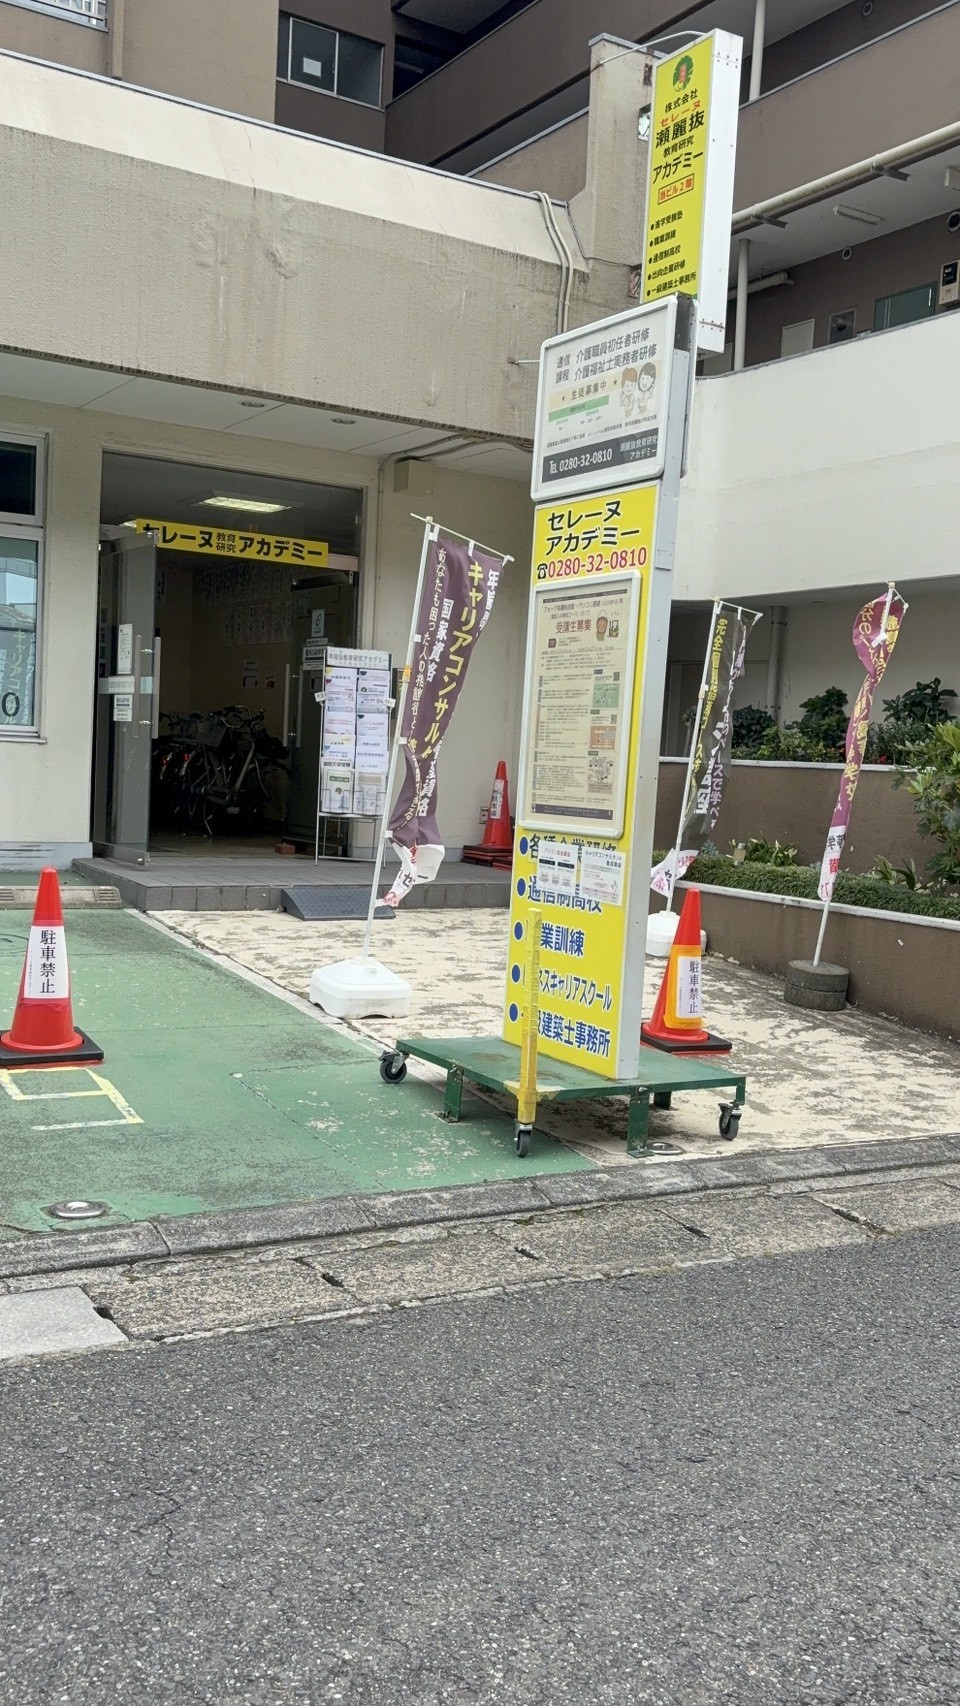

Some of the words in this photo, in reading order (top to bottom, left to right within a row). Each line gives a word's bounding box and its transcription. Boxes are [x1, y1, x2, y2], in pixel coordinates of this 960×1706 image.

[660, 100, 701, 127] セレーヌ
[665, 88, 698, 113] 株式会社
[656, 110, 705, 149] 瀬麗抜
[663, 135, 695, 158] 教育研究
[652, 151, 704, 184] アカデミー
[555, 369, 570, 384] 課程
[574, 343, 658, 382] 介護福祉士実務者研修
[556, 354, 571, 369] 通信
[576, 327, 651, 364] 介護職員初任者研修
[571, 381, 607, 400] 生徒募集中
[560, 448, 613, 472] 0280-32-0810
[629, 448, 657, 460] アカデミー
[547, 500, 622, 532] セレーヌ
[216, 532, 236, 543] 教育
[216, 542, 237, 554] 研究
[238, 535, 323, 561] アカデミー
[545, 526, 640, 556] アカデミー
[548, 546, 647, 579] 0280-32-0810
[426, 598, 455, 684] 国家資格
[555, 618, 592, 635] 受講生募集
[585, 850, 622, 861] キャリアコンサルタント
[526, 919, 585, 958] 業訓練
[39, 929, 57, 994] 駐車禁止
[523, 964, 613, 1011] スキャリアスクール
[688, 960, 700, 1014] 駐車禁止
[521, 1008, 611, 1058] 建築士事務所
